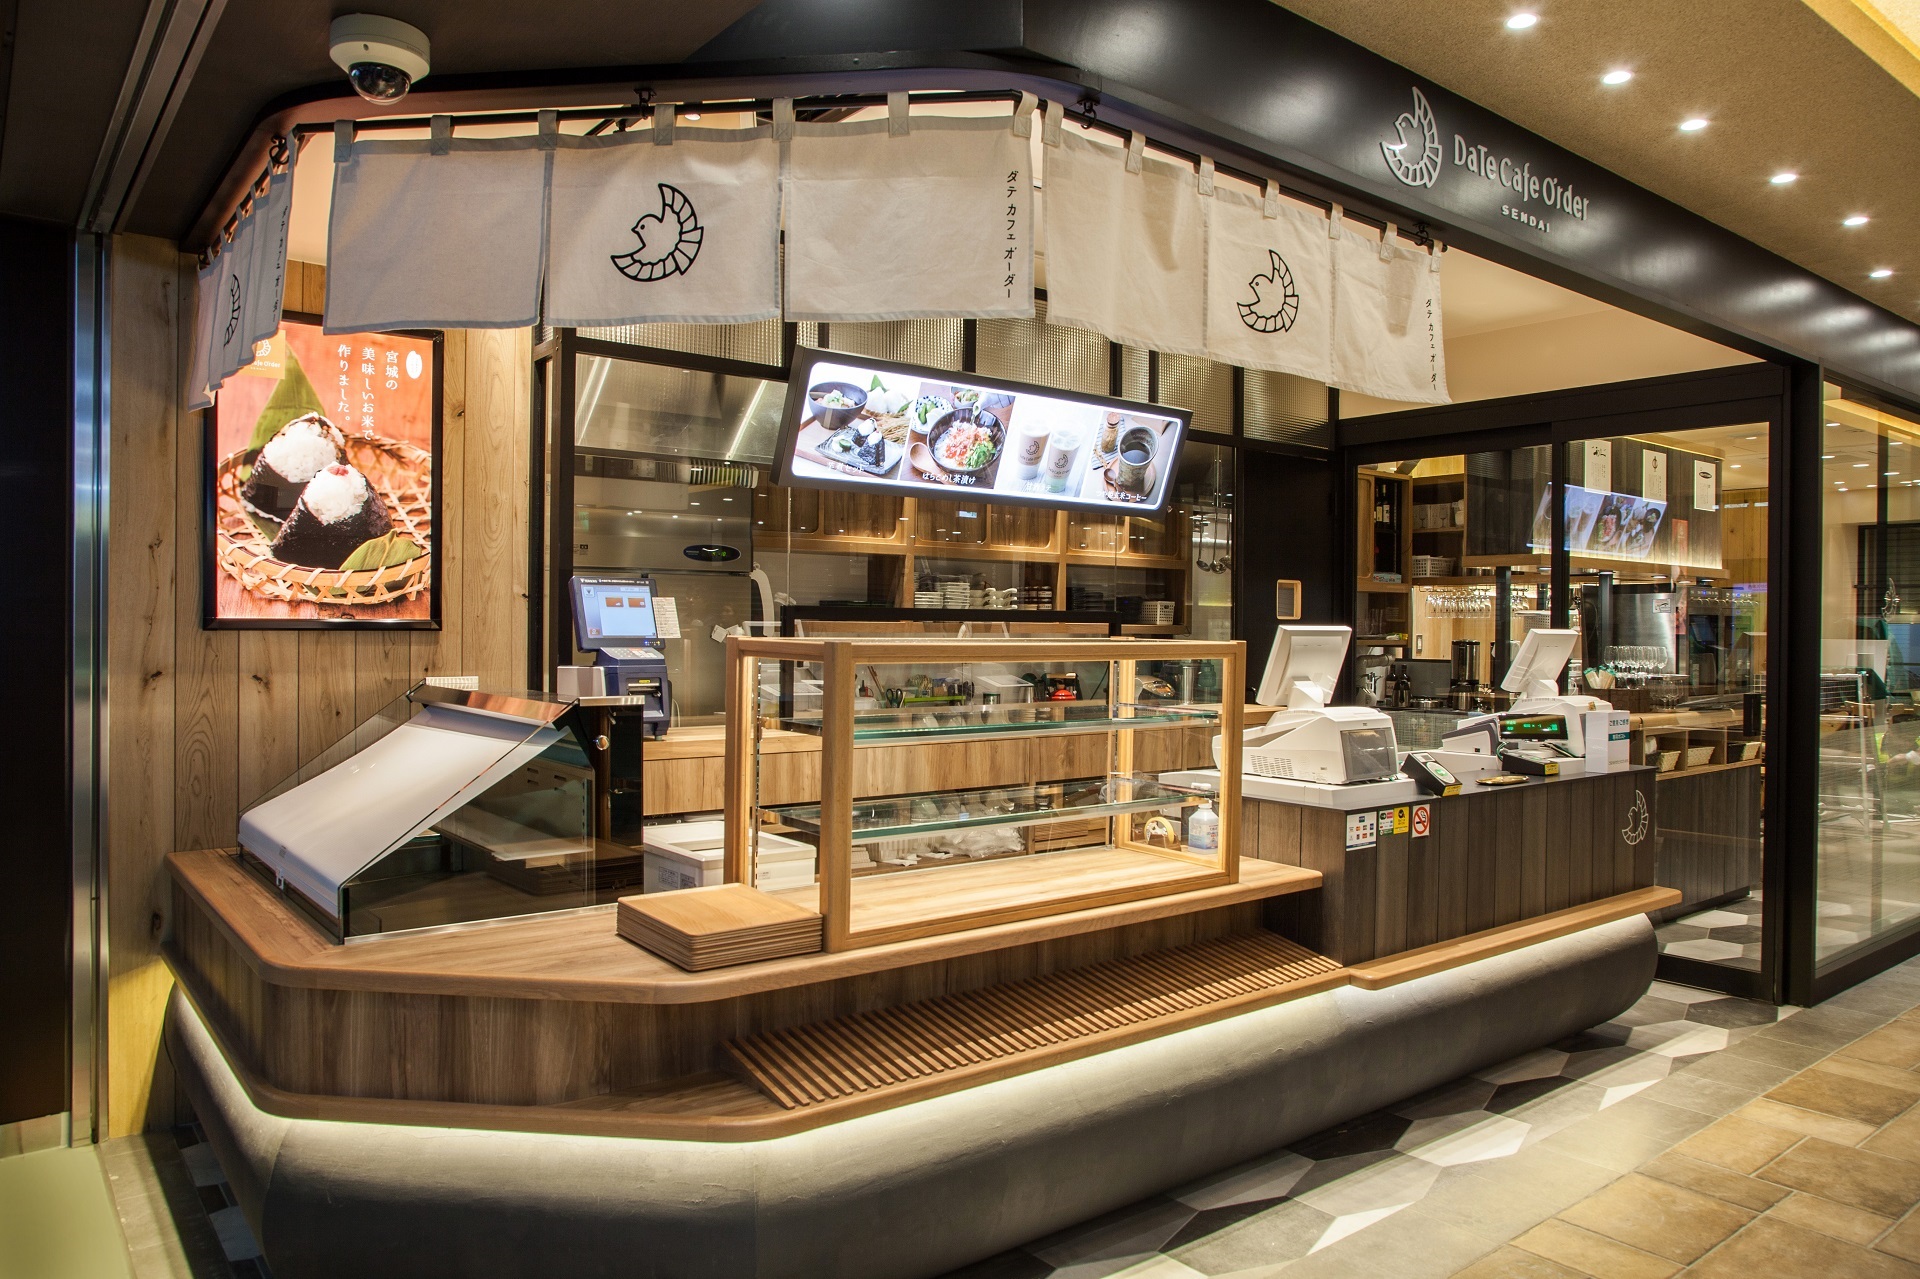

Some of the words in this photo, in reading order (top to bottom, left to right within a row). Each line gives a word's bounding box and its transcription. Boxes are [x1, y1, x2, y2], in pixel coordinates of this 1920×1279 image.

[1499, 156, 1540, 202] Cafe
[1501, 204, 1551, 233] SENDAI
[337, 344, 351, 422] 作りました。
[385, 350, 399, 390] 宮城の
[361, 347, 376, 441] 美味しいお米で
